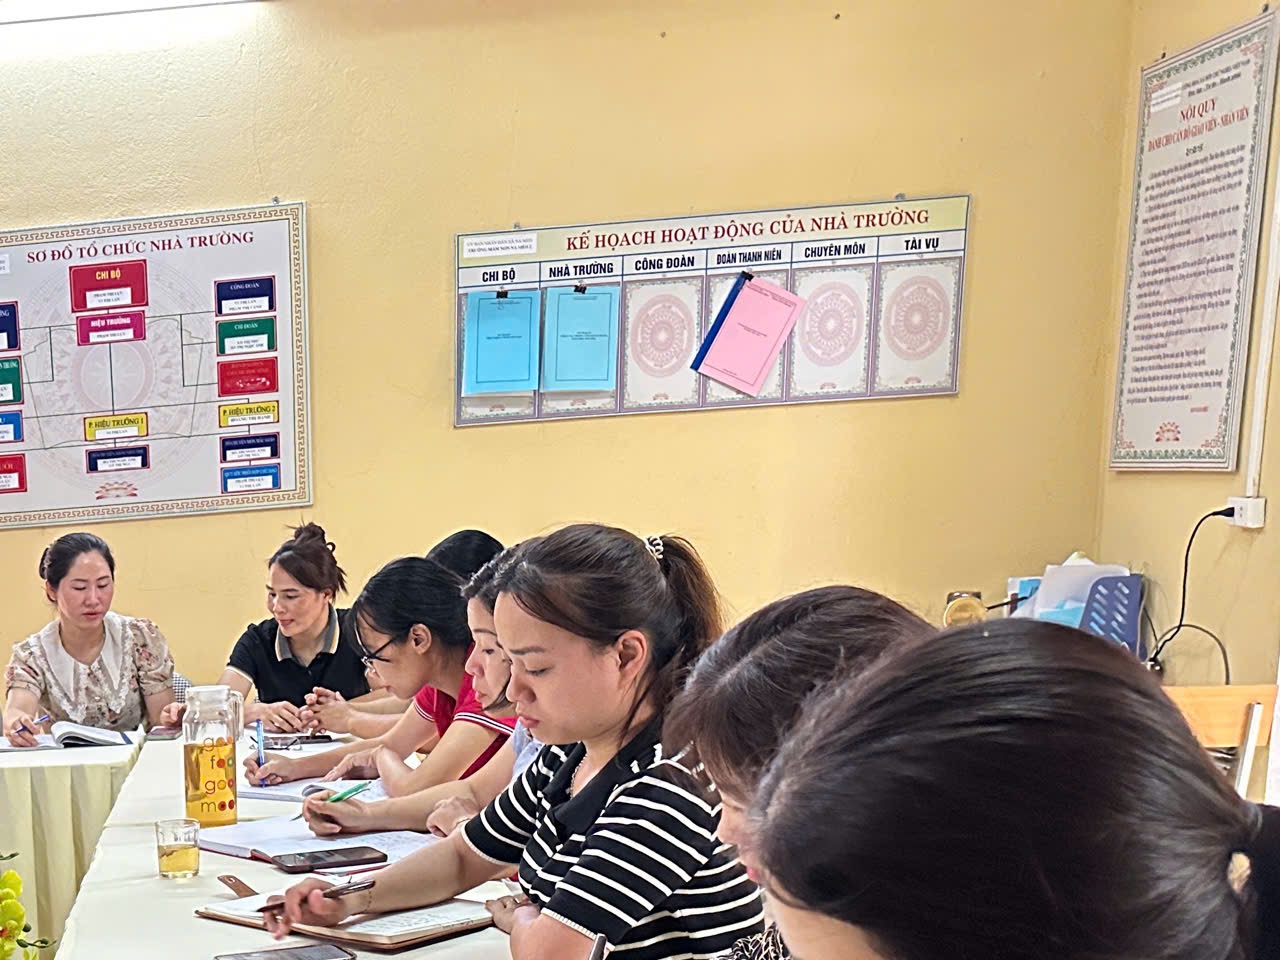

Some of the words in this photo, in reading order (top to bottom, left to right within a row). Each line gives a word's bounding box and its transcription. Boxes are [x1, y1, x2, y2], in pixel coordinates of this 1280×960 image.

[567, 230, 590, 250] KẾ
[662, 226, 708, 245] HOẠT
[714, 220, 763, 242] ĐỘNG
[770, 214, 805, 235] CỦA
[811, 212, 848, 231] NHÀ
[854, 207, 929, 229] TRƯỜNG
[27, 249, 46, 263] SƠ
[51, 243, 72, 261] ĐỒ
[77, 240, 98, 258] TỔ
[102, 239, 145, 256] CHỨC
[150, 234, 183, 252] NHÀ
[187, 231, 254, 249] TRƯỜNG
[804, 243, 841, 258] CHUYÊN
[844, 241, 866, 255] MÔN
[904, 236, 921, 251] TÀI
[925, 237, 940, 251] VỤ
[635, 257, 663, 271] CÔNG
[666, 254, 695, 269] ĐOÀN
[716, 249, 737, 265] ĐOÀN
[738, 249, 762, 263] THANH
[764, 247, 782, 261] NIÊN
[96, 271, 108, 280] CHI
[110, 268, 121, 280] BỘ
[482, 271, 499, 283] CHI
[502, 268, 516, 283] BỘ
[549, 264, 570, 278] NHÀ
[573, 260, 614, 276] TRƯỜNG
[229, 406, 244, 417] HIỆU
[94, 419, 111, 428] HIỆU
